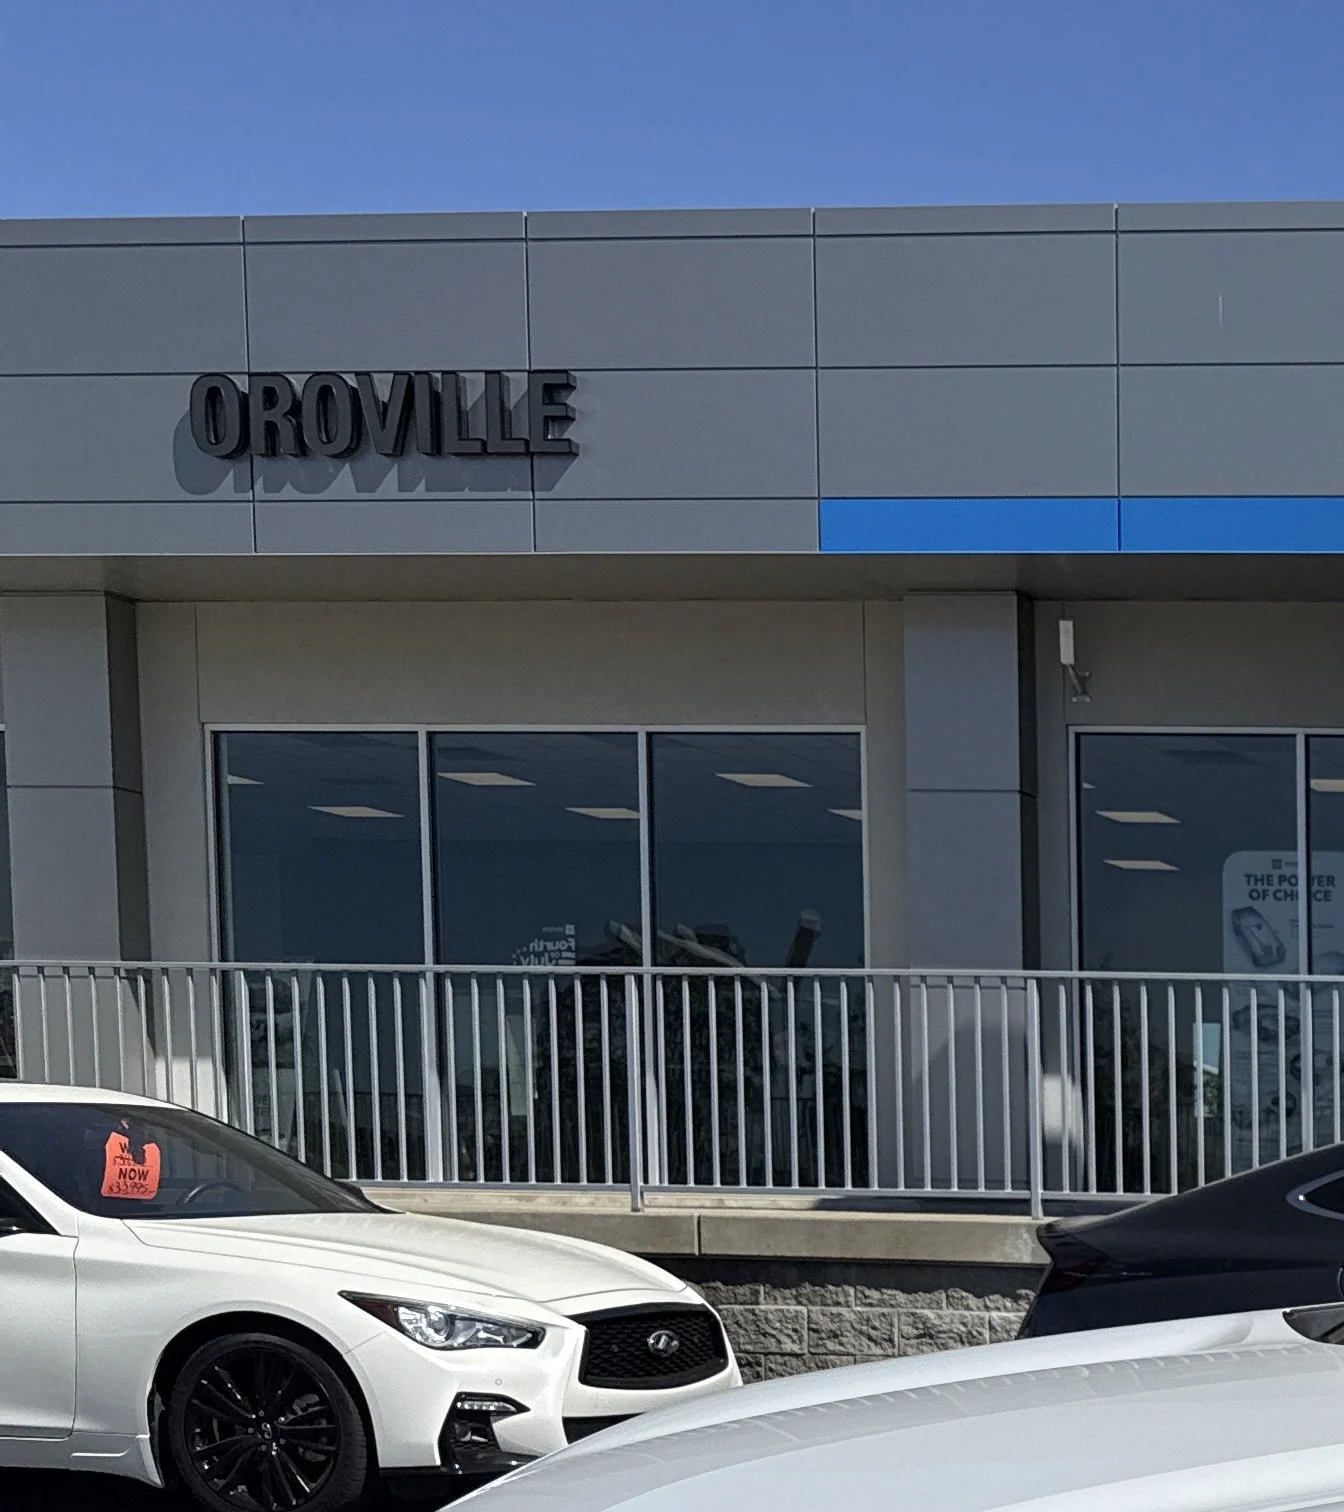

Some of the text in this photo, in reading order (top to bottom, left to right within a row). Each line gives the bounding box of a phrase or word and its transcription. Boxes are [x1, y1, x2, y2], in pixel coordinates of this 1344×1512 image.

[190, 370, 580, 458] OROVILLE
[1244, 874, 1337, 888] THE POER
[1248, 889, 1333, 902] OF CHCE
[118, 1167, 150, 1181] NOW
